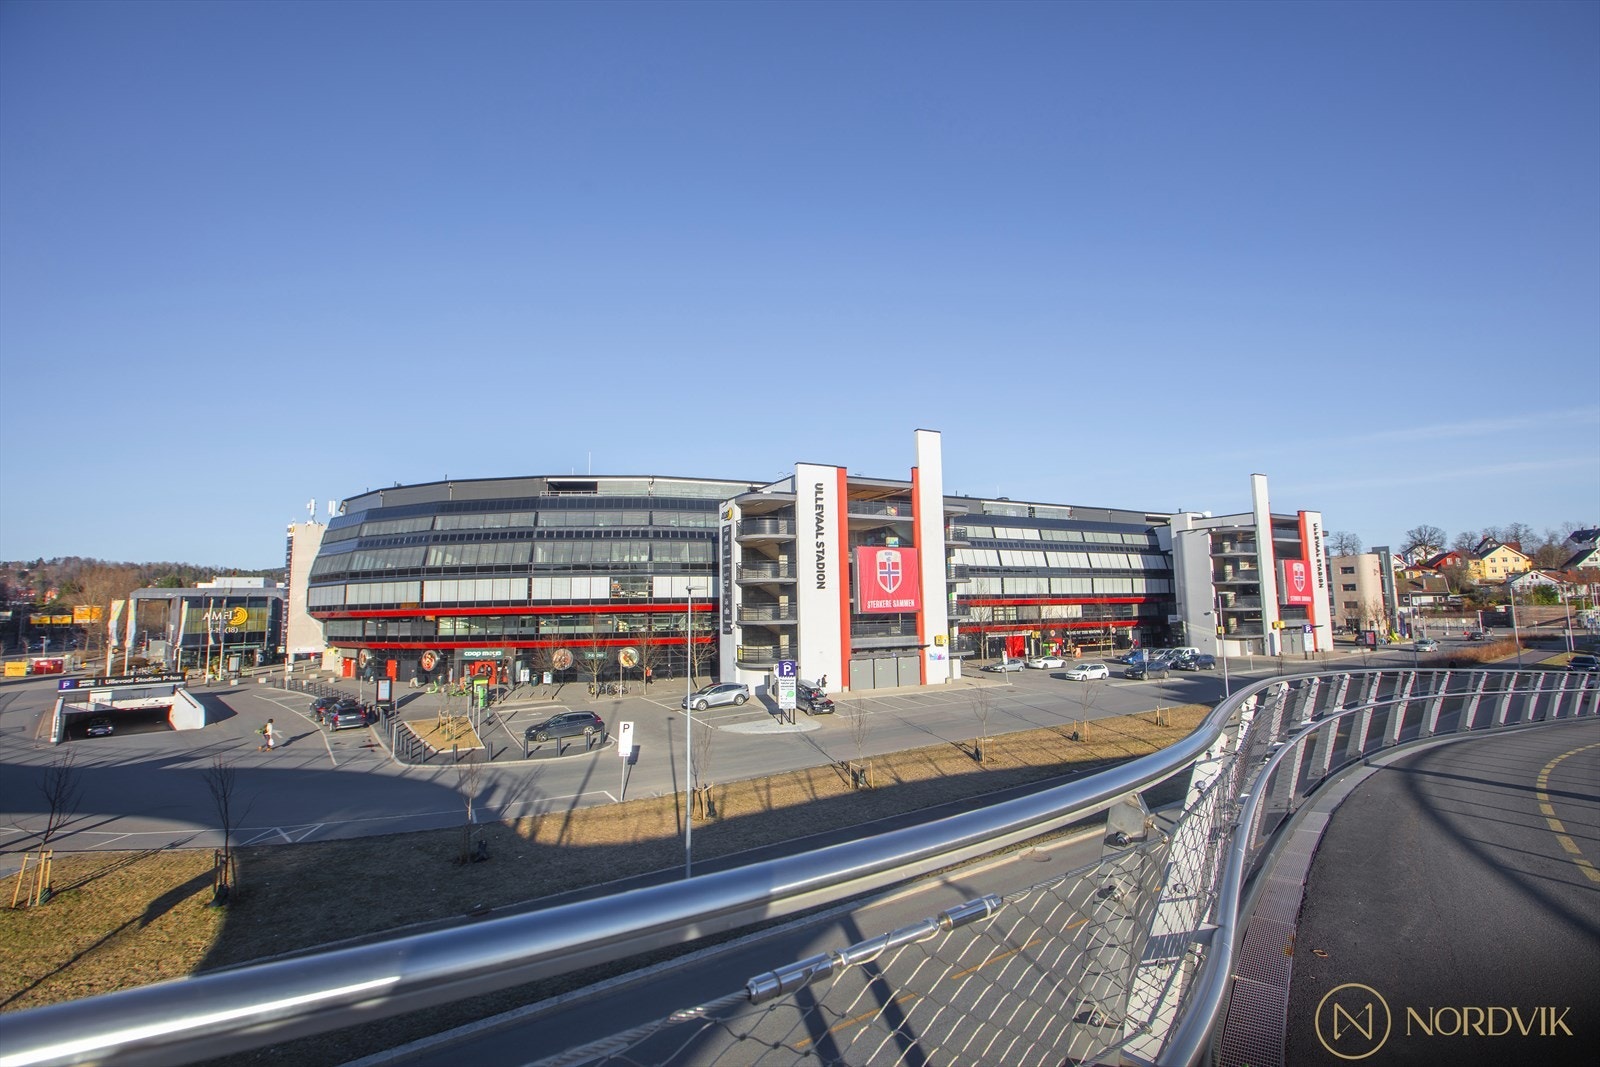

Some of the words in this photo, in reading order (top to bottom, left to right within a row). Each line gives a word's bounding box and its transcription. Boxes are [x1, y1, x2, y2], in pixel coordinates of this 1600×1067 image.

[814, 483, 825, 539] ULLEVAAL
[816, 541, 826, 590] STADION
[867, 600, 892, 608] STERKERE
[892, 599, 915, 607] SAMMEN
[623, 723, 630, 733] P
